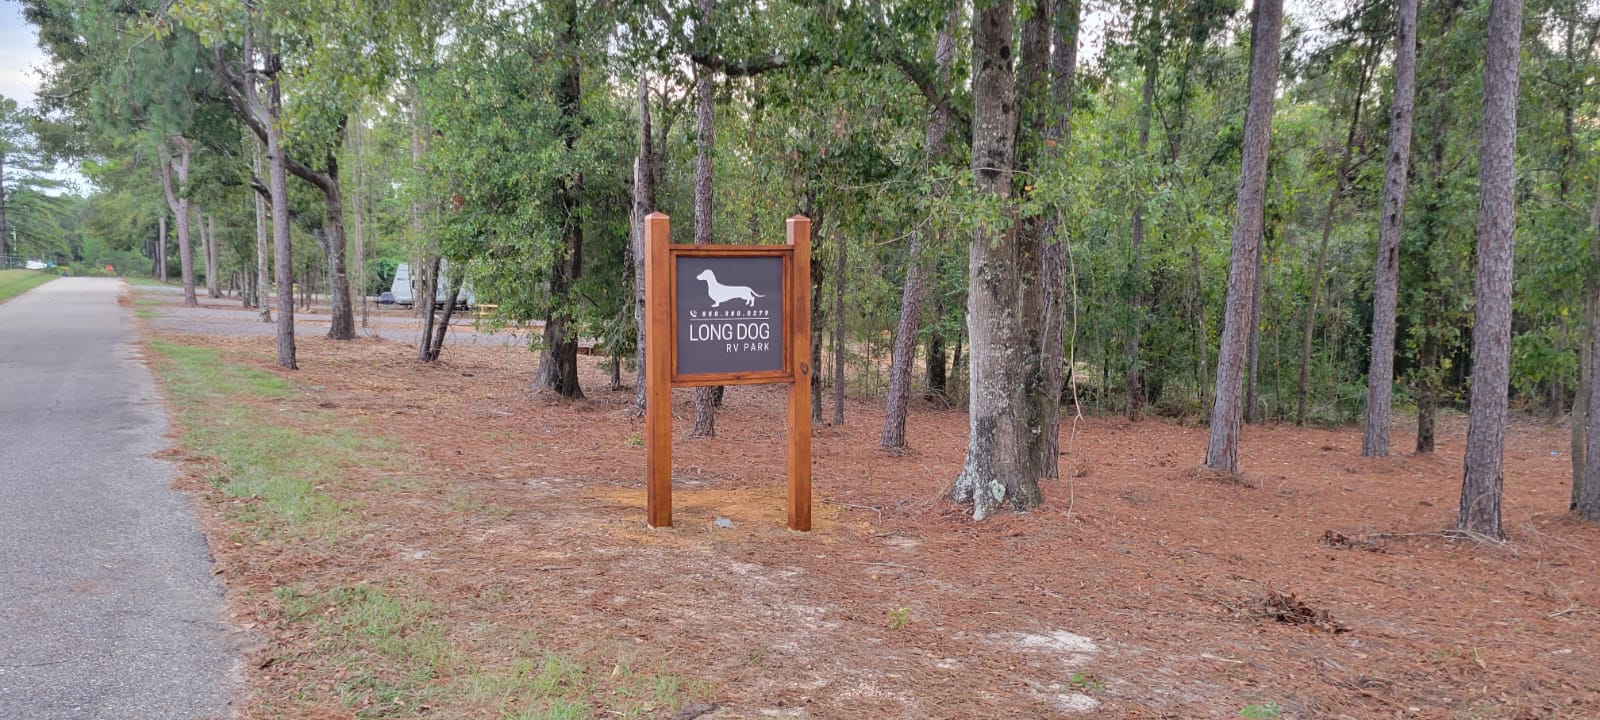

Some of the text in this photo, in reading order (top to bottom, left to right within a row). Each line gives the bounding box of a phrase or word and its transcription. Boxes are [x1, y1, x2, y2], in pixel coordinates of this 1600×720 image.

[690, 322, 770, 341] LONG DOG
[726, 342, 770, 353] RV PARK
